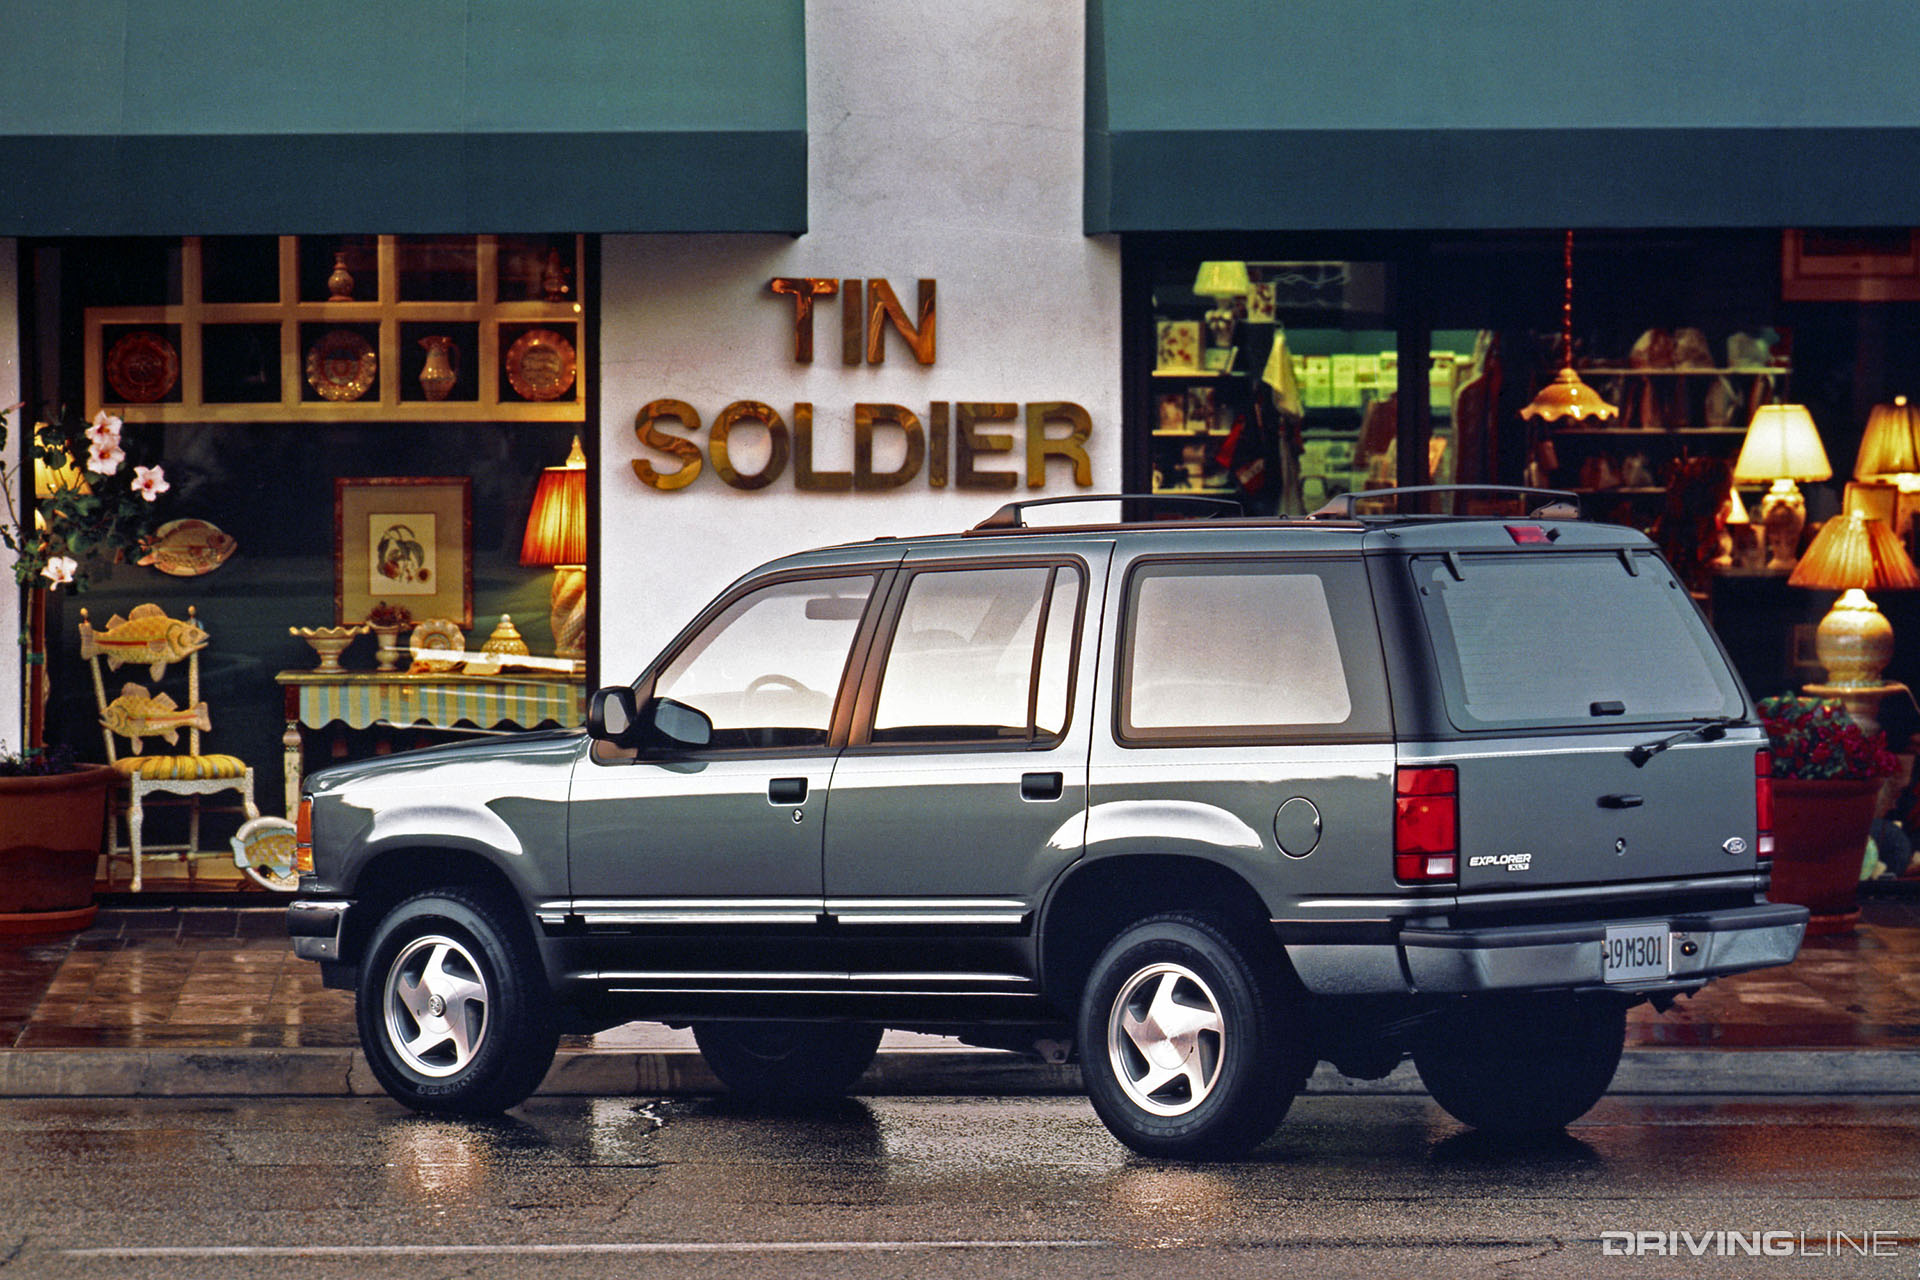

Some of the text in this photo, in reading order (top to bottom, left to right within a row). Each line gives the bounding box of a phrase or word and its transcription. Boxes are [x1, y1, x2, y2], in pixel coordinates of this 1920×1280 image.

[771, 278, 936, 365] TIN
[632, 399, 1093, 491] SOLDIER
[1469, 853, 1532, 867] EXPLORER
[1609, 936, 1662, 969] 19M301
